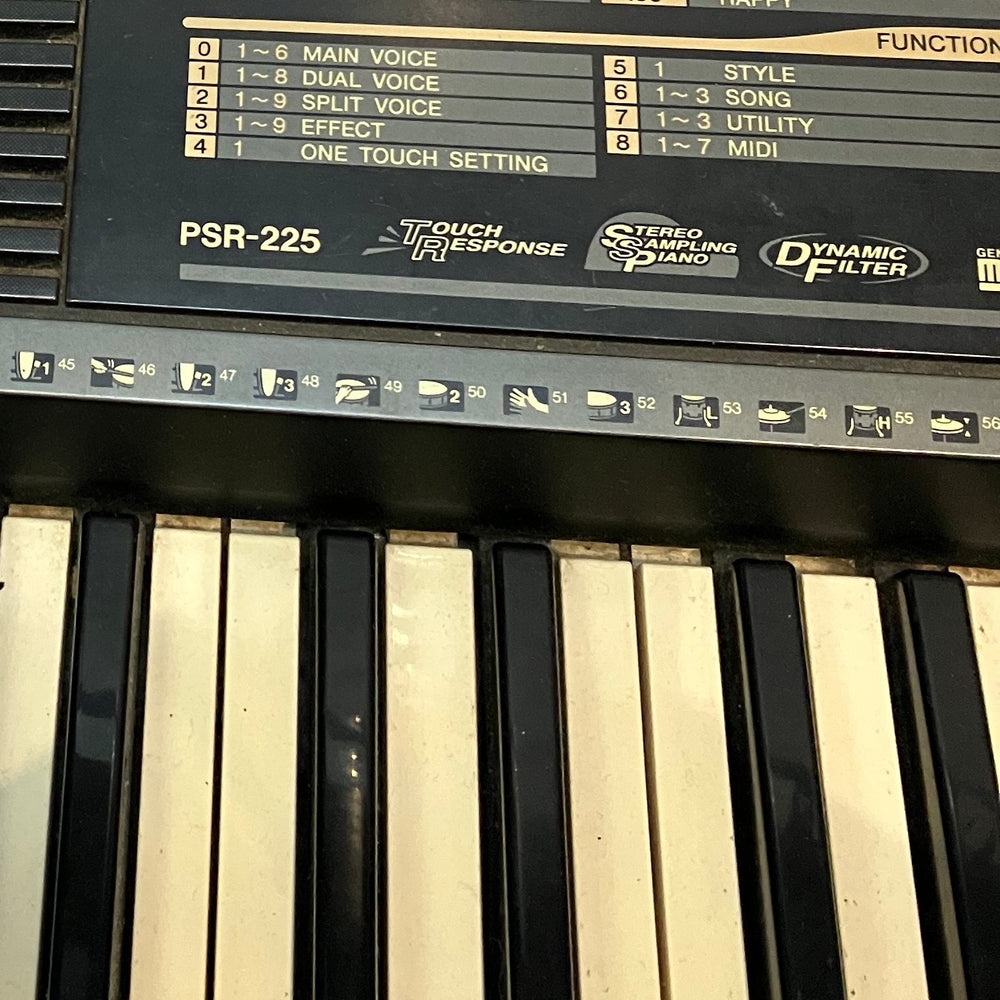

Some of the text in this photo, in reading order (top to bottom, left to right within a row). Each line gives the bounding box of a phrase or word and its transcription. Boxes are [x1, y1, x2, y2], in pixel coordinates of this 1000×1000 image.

[199, 42, 210, 56] 0
[304, 46, 437, 66] MAIN VOICE
[199, 66, 205, 80] 1
[614, 60, 626, 74] 5
[725, 64, 795, 82] STYLE
[303, 70, 439, 91] DUAL VOICE
[197, 89, 208, 104] 2
[615, 84, 627, 99] 6
[726, 89, 791, 107] SONG
[302, 94, 442, 116] SPLIT VOICE
[195, 114, 207, 129] 3
[616, 110, 627, 124] 7
[728, 114, 814, 134] UTILITY
[302, 119, 385, 138] EFFECT
[194, 139, 206, 153] 4
[617, 135, 629, 150] 8
[729, 140, 777, 157] MIDI
[301, 144, 548, 172] ONE TOUCH SETTING
[181, 222, 320, 253] PSR-225
[775, 241, 907, 267] DYNAMIC
[804, 258, 908, 283] FILTER
[58, 359, 75, 370] 45
[138, 364, 155, 375] 46
[220, 370, 236, 381] 47
[302, 375, 319, 387] 48
[384, 381, 402, 392] 49
[468, 386, 486, 398] 50
[553, 391, 567, 403] 51
[638, 397, 655, 409] 52
[723, 402, 741, 414] 53
[809, 407, 827, 419] 54
[895, 412, 913, 424] 55
